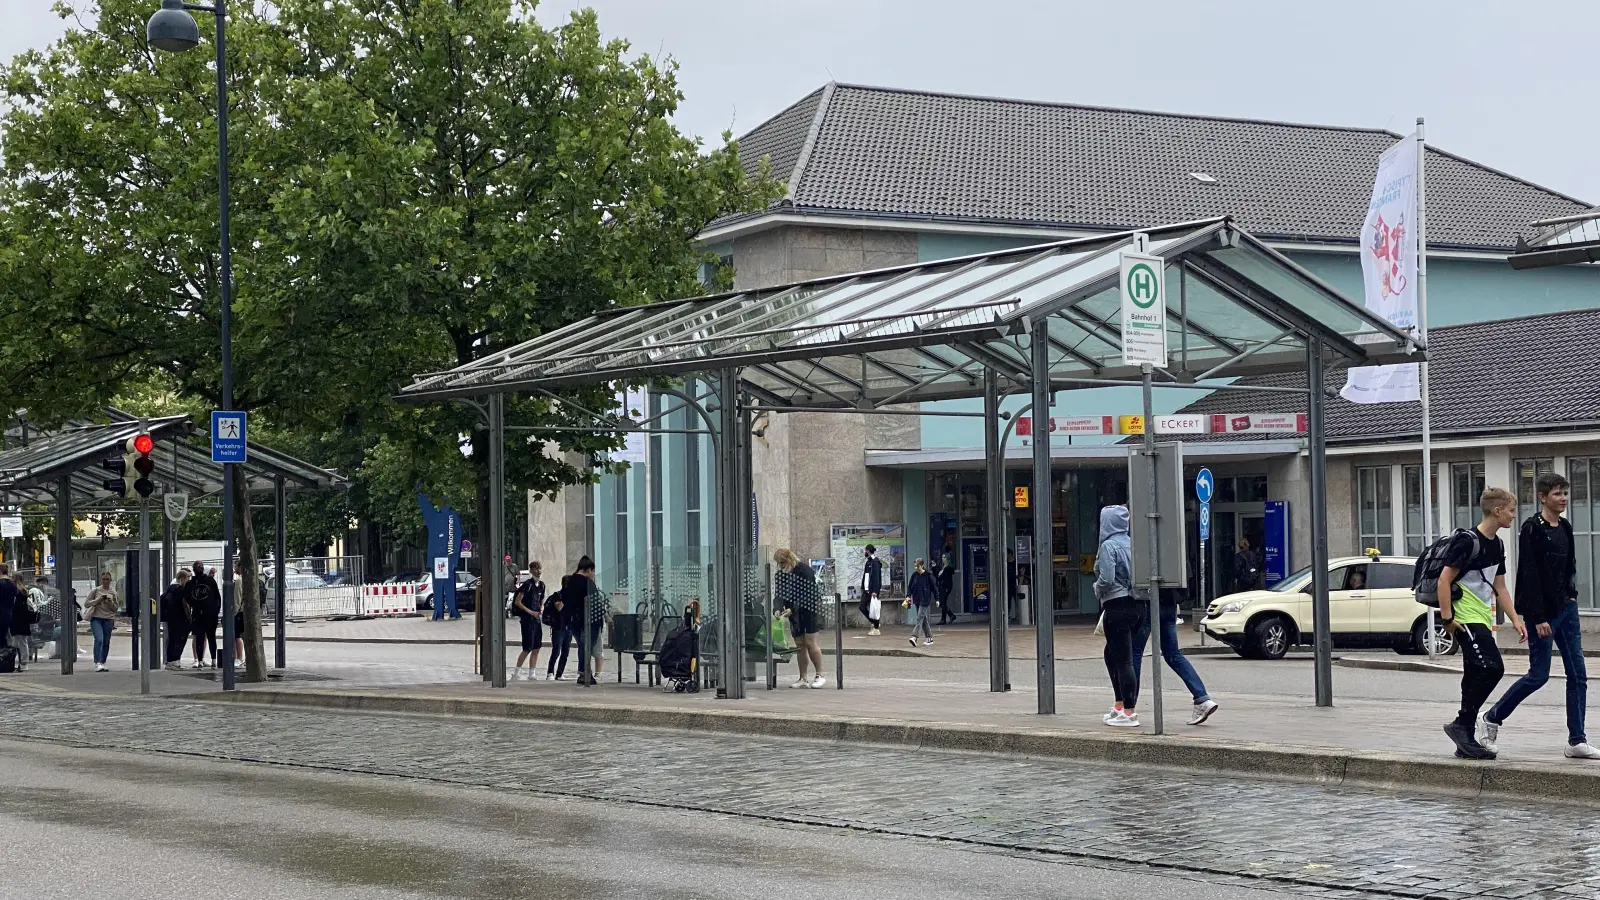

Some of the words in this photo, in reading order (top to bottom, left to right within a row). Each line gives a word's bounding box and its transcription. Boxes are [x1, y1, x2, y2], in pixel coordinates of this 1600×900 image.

[1137, 236, 1143, 253] 1
[1135, 273, 1150, 298] H
[1131, 313, 1153, 322] Bahnhof
[1161, 419, 1200, 429] ECKERT
